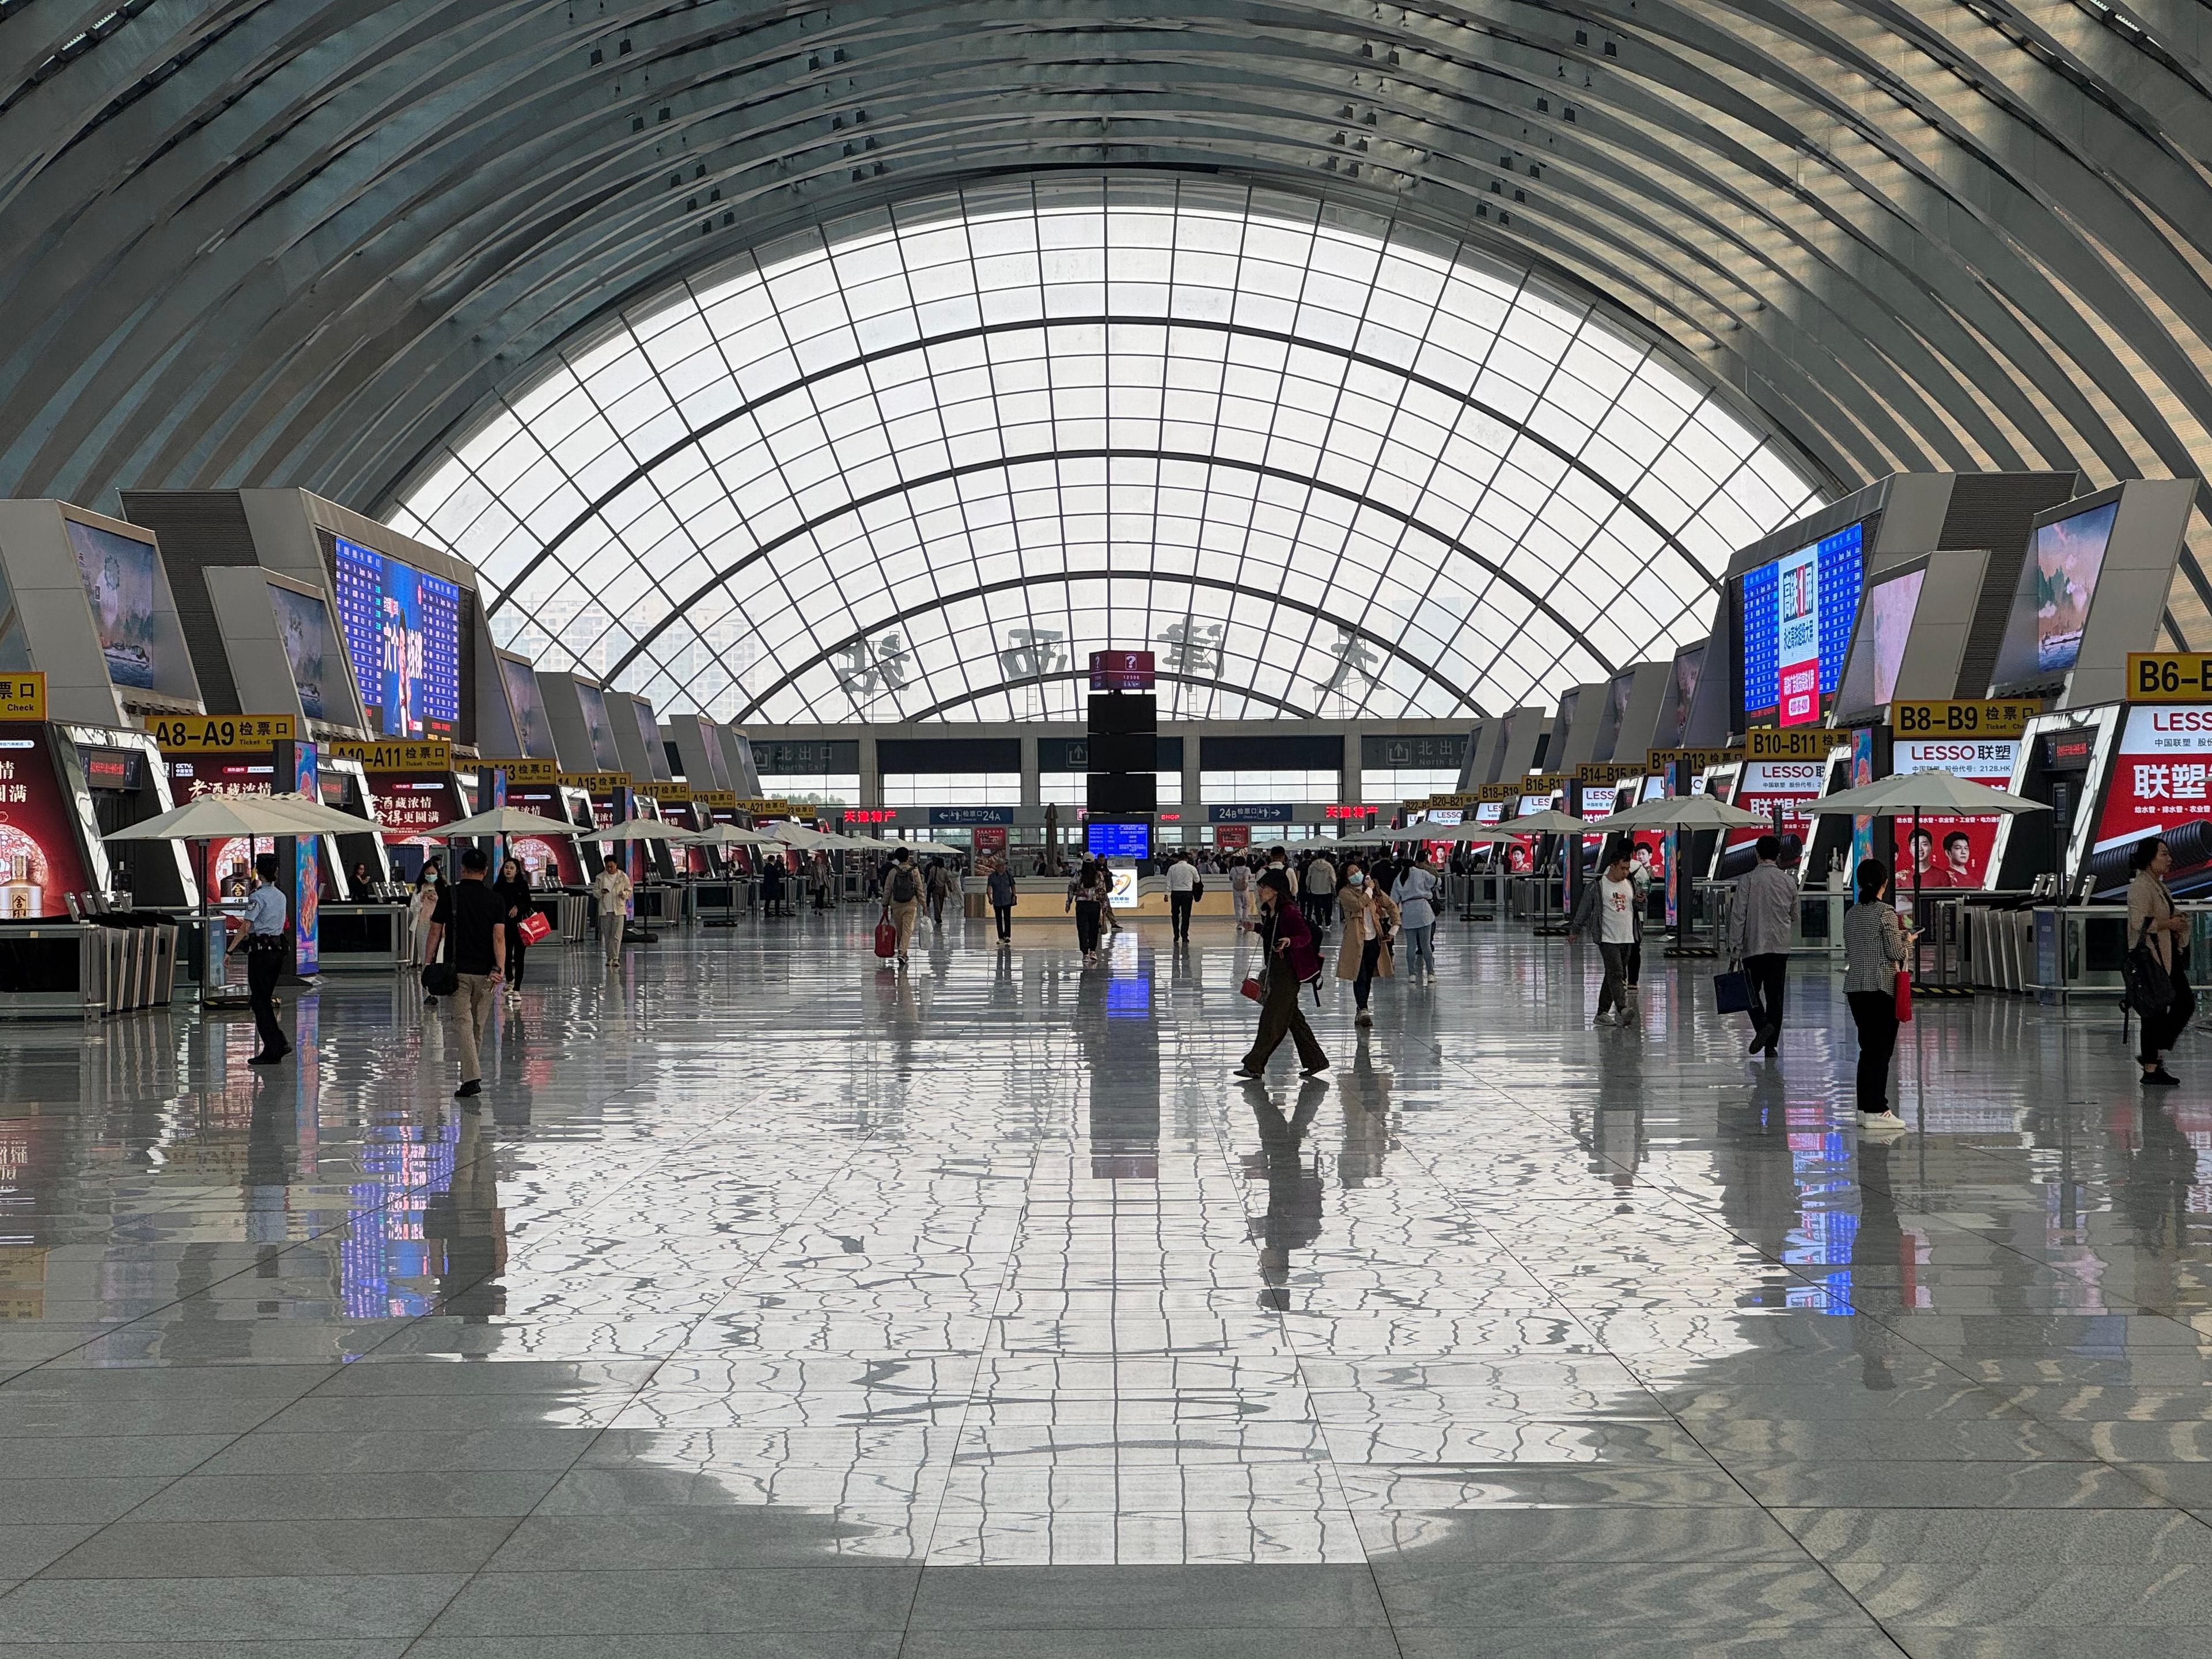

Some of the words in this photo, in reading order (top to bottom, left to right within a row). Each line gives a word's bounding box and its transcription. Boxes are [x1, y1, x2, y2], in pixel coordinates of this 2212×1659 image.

[1901, 706, 1978, 730] B8-B9
[1985, 707, 2034, 720] 检票口
[155, 721, 234, 747] A8-A9
[239, 722, 287, 736] 检票口
[1754, 734, 1815, 753] B10-B11
[2155, 738, 2191, 747] 中国联塑
[406, 747, 444, 759] 检票口
[778, 746, 832, 760] 北出口
[1911, 745, 1975, 760] LESSO
[1978, 745, 2010, 760] 联塑
[519, 764, 551, 773] 检票口
[1763, 766, 1813, 778] LESSO
[2134, 764, 2207, 800] 联塑
[983, 810, 1001, 821] 24A
[1219, 808, 1237, 819] 24B
